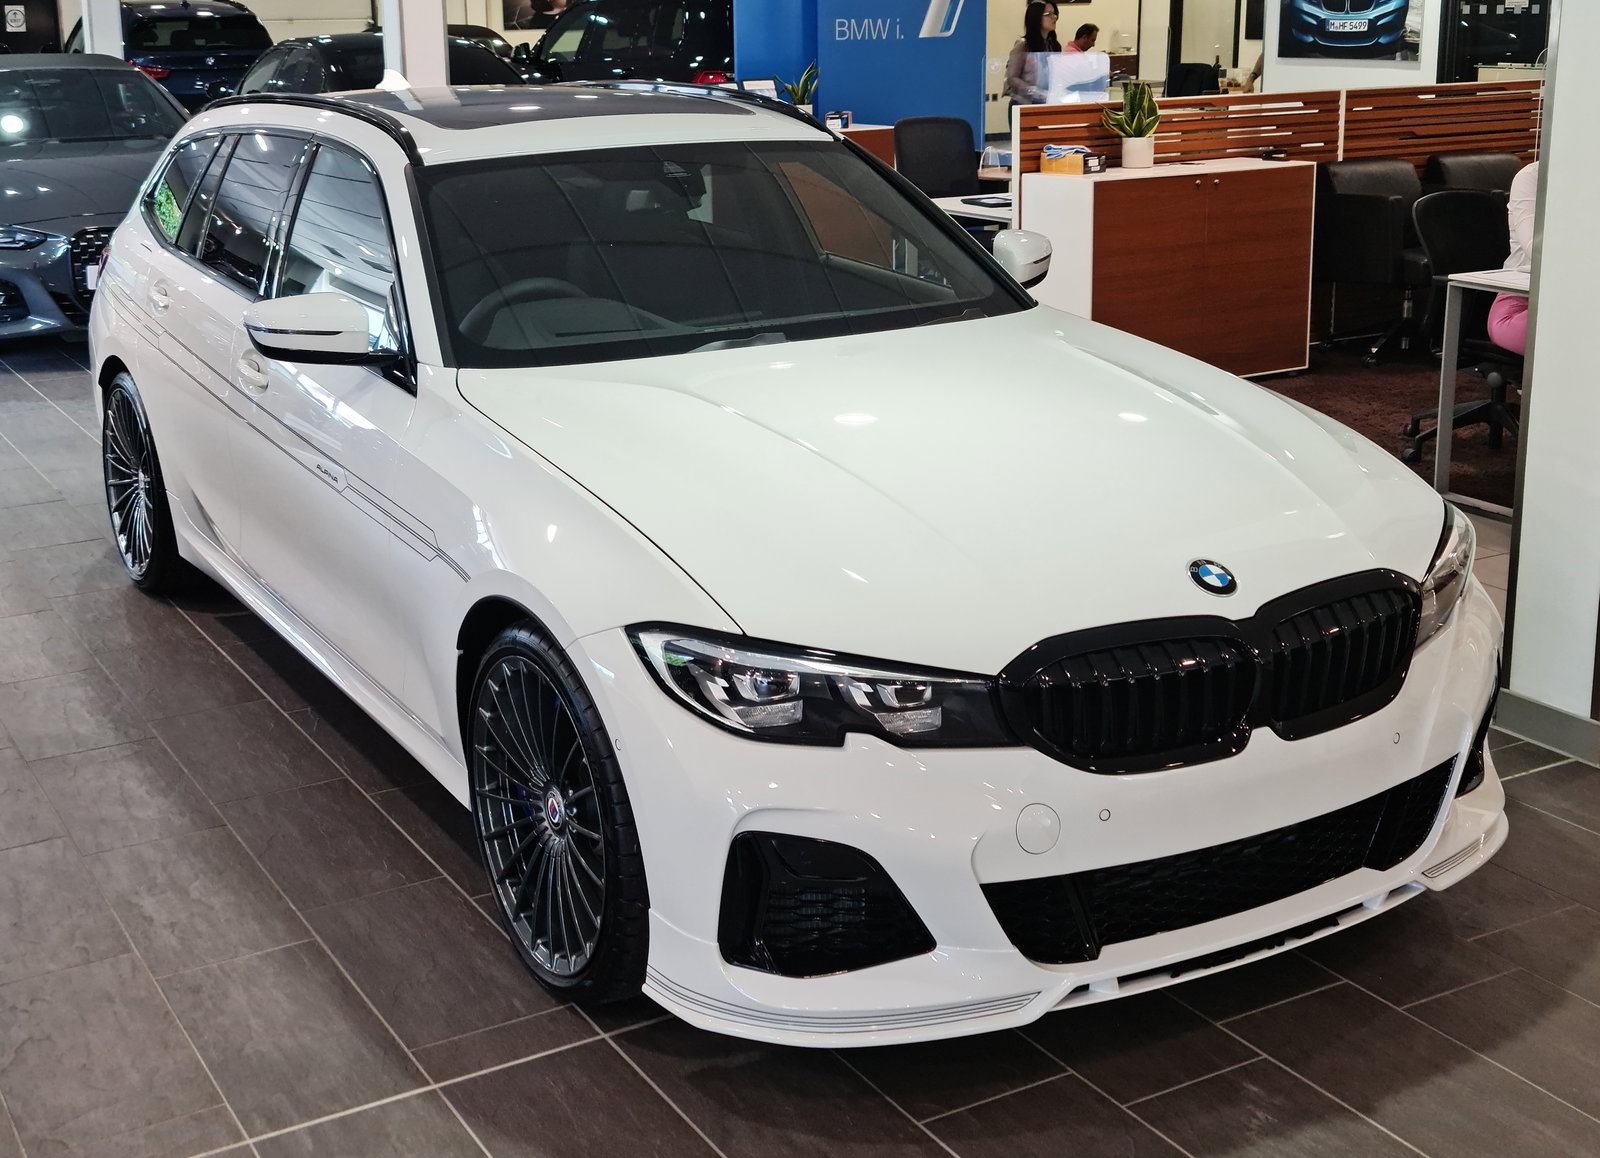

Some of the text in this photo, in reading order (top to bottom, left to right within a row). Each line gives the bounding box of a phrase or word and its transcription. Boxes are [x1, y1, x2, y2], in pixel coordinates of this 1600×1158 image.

[835, 18, 904, 41] BMW i.
[1348, 21, 1368, 31] 5499
